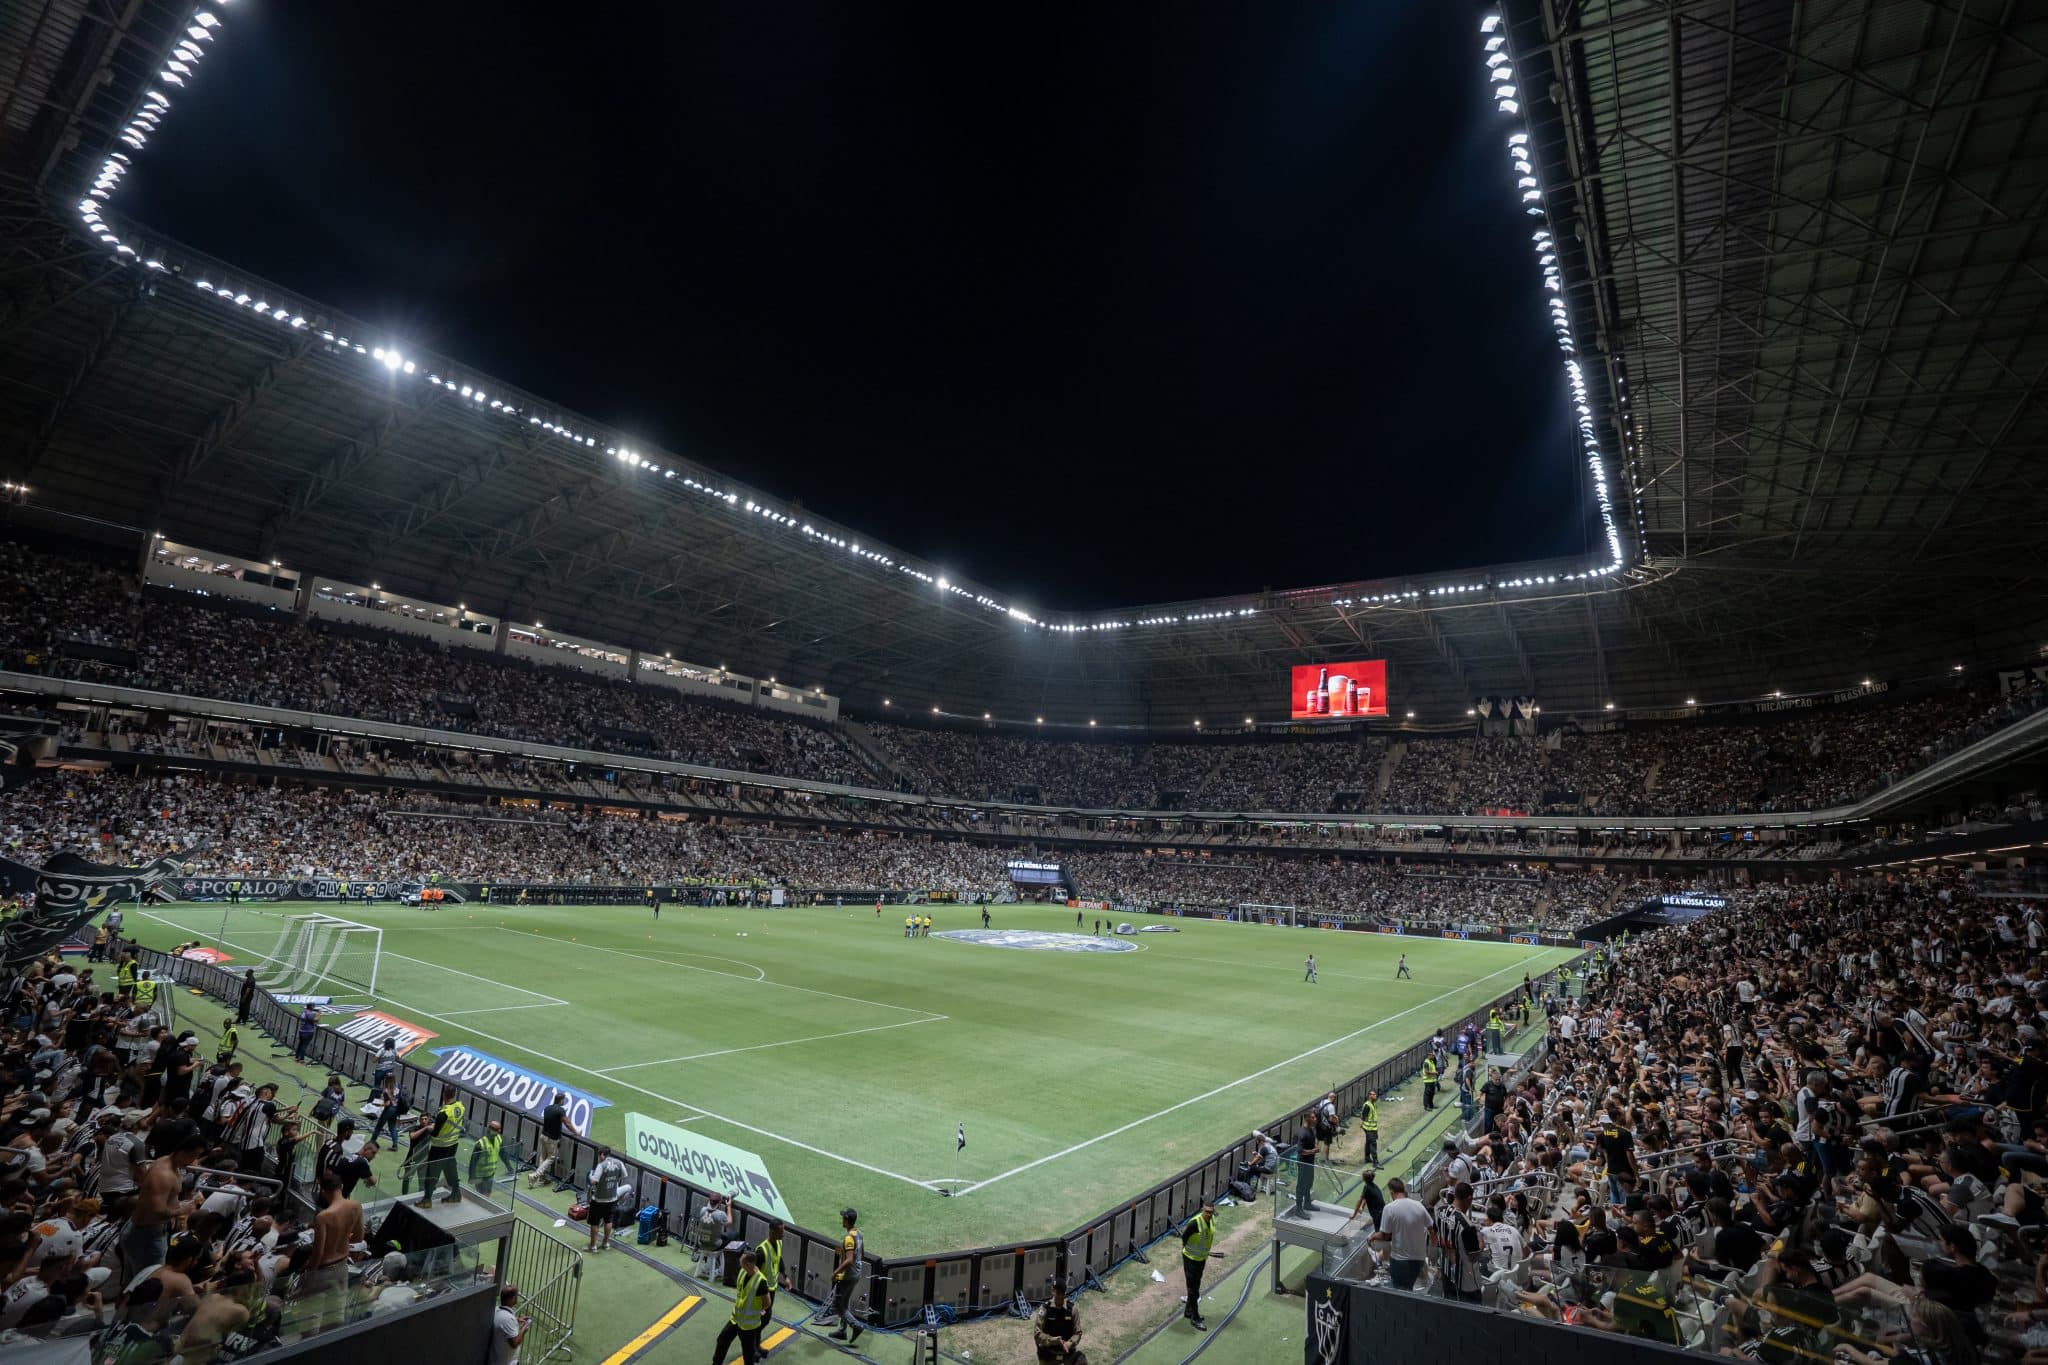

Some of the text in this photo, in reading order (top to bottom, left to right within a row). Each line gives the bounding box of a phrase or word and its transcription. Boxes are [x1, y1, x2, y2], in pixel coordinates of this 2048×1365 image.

[1078, 901, 1103, 910] BETANO
[1681, 897, 1704, 907] NOSSA
[1704, 899, 1725, 908] CASA!
[1320, 922, 1341, 930] BRAX
[1380, 927, 1402, 935] BRAX
[1444, 931, 1466, 940] BRAX
[1512, 936, 1536, 945] BRAX
[1502, 1245, 1514, 1271] 7
